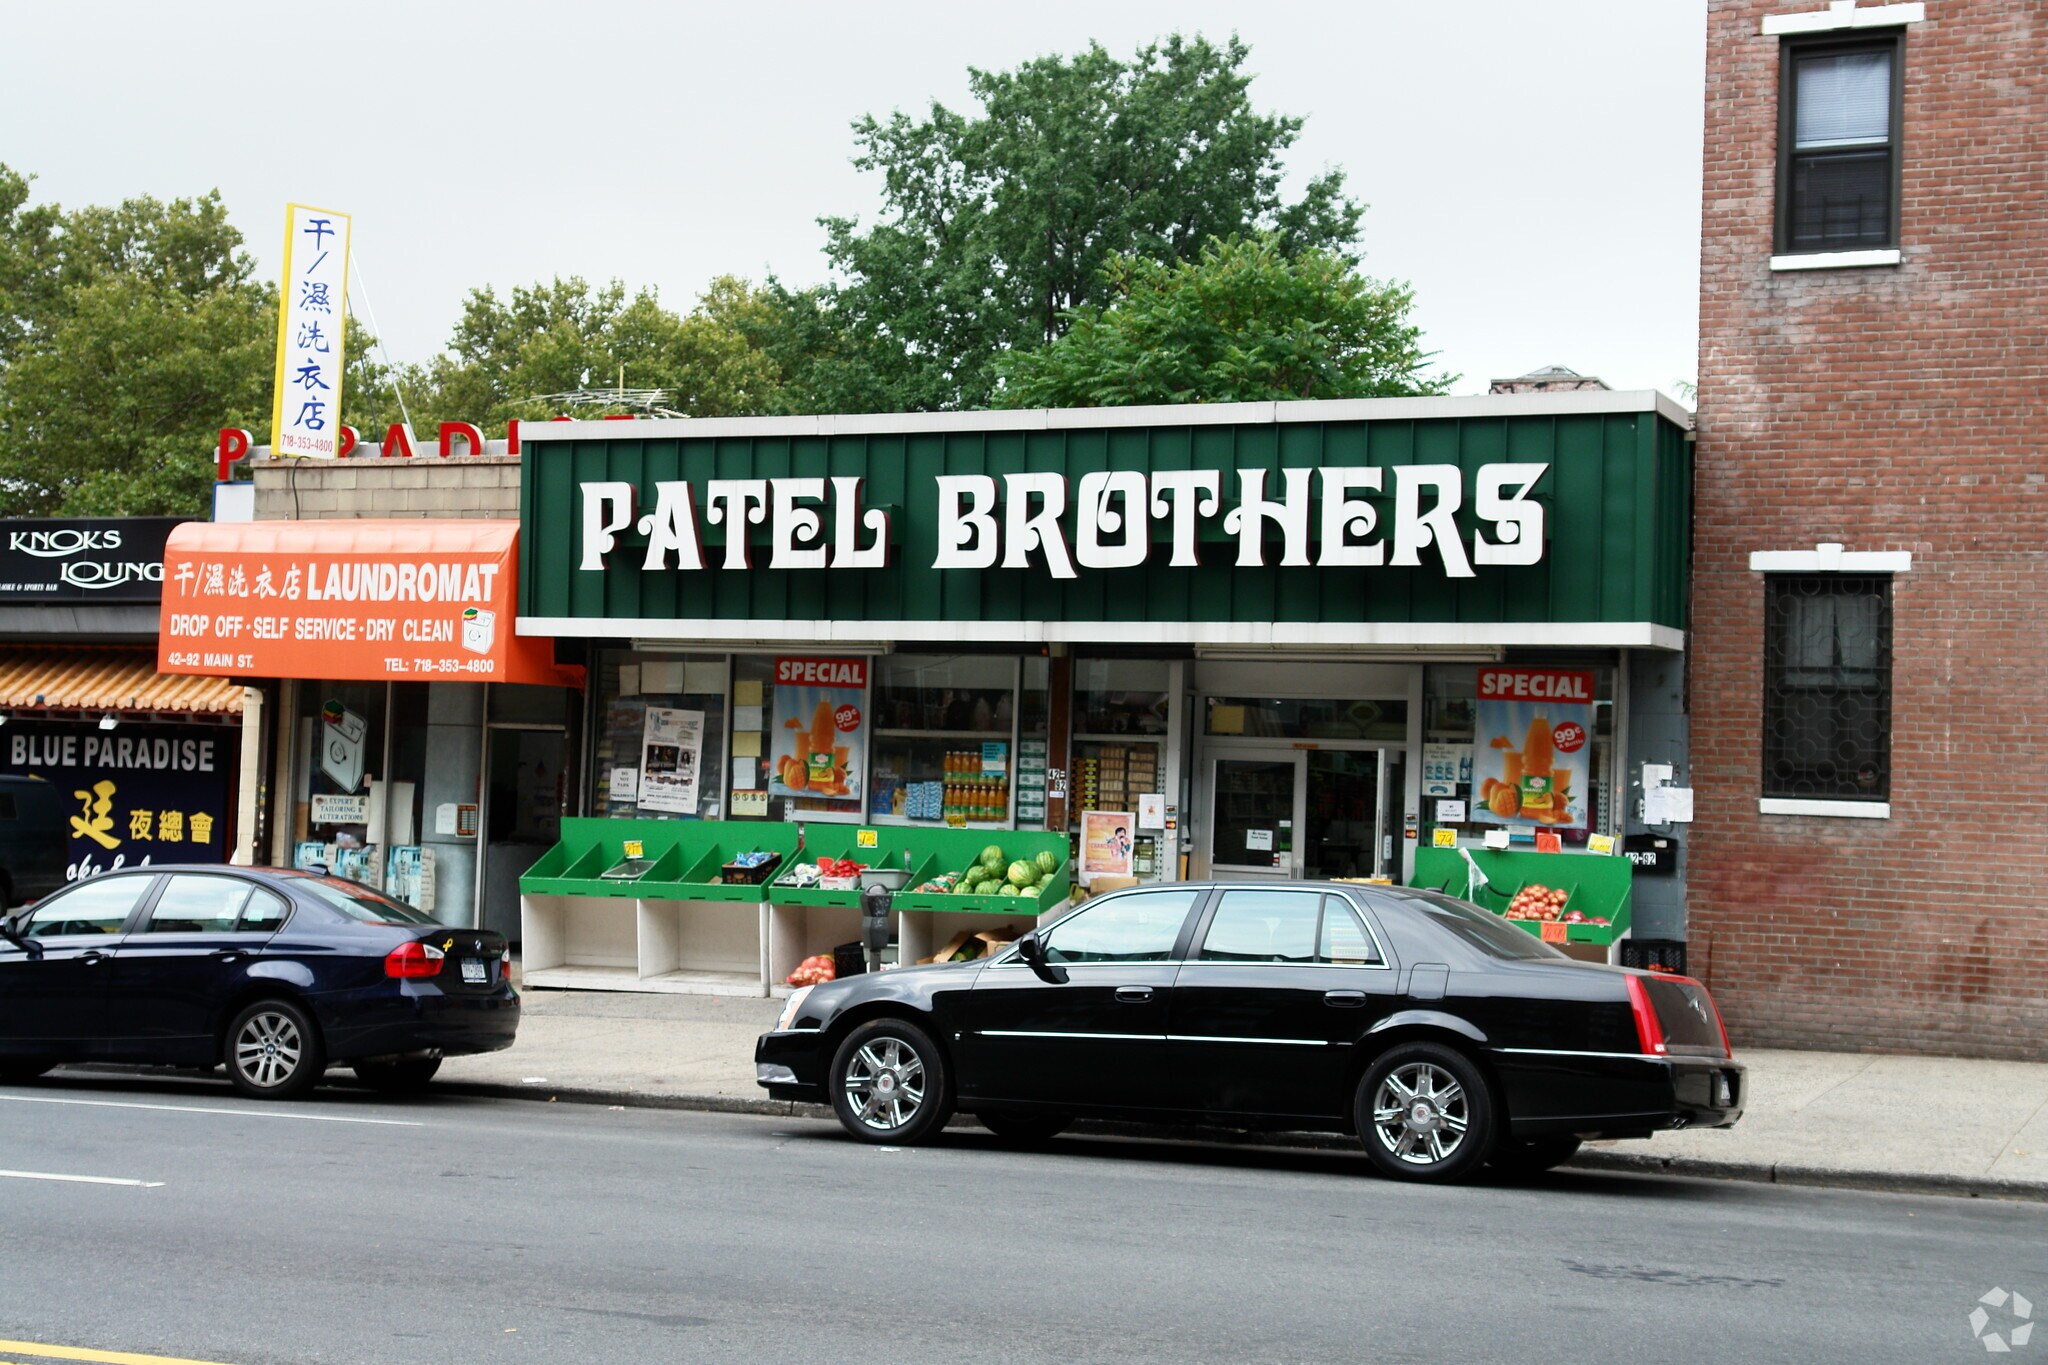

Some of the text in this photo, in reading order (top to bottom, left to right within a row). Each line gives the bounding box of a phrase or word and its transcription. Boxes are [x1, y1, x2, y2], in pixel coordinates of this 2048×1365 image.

[282, 434, 333, 452] 718-353-4800
[579, 463, 1549, 578] PATEL BROTHERS
[10, 530, 122, 557] KNOKS
[24, 583, 44, 591] SPORTS
[307, 563, 498, 602] LAUNDROMAT
[170, 614, 453, 642] DROP OFF SELF SERVICE DRY CLEAN
[168, 652, 254, 668] 42-92 MAIN ST.
[384, 657, 494, 673] TEL: 718-353-4800
[779, 661, 863, 684] SPECIAL
[1482, 672, 1589, 699] SPECIAL
[1554, 726, 1582, 743] 99¢
[11, 734, 214, 772] BLUE PARADISE
[1055, 780, 1066, 790] 92
[130, 809, 214, 844] 夜總會
[319, 813, 363, 821] ALTERATIONS
